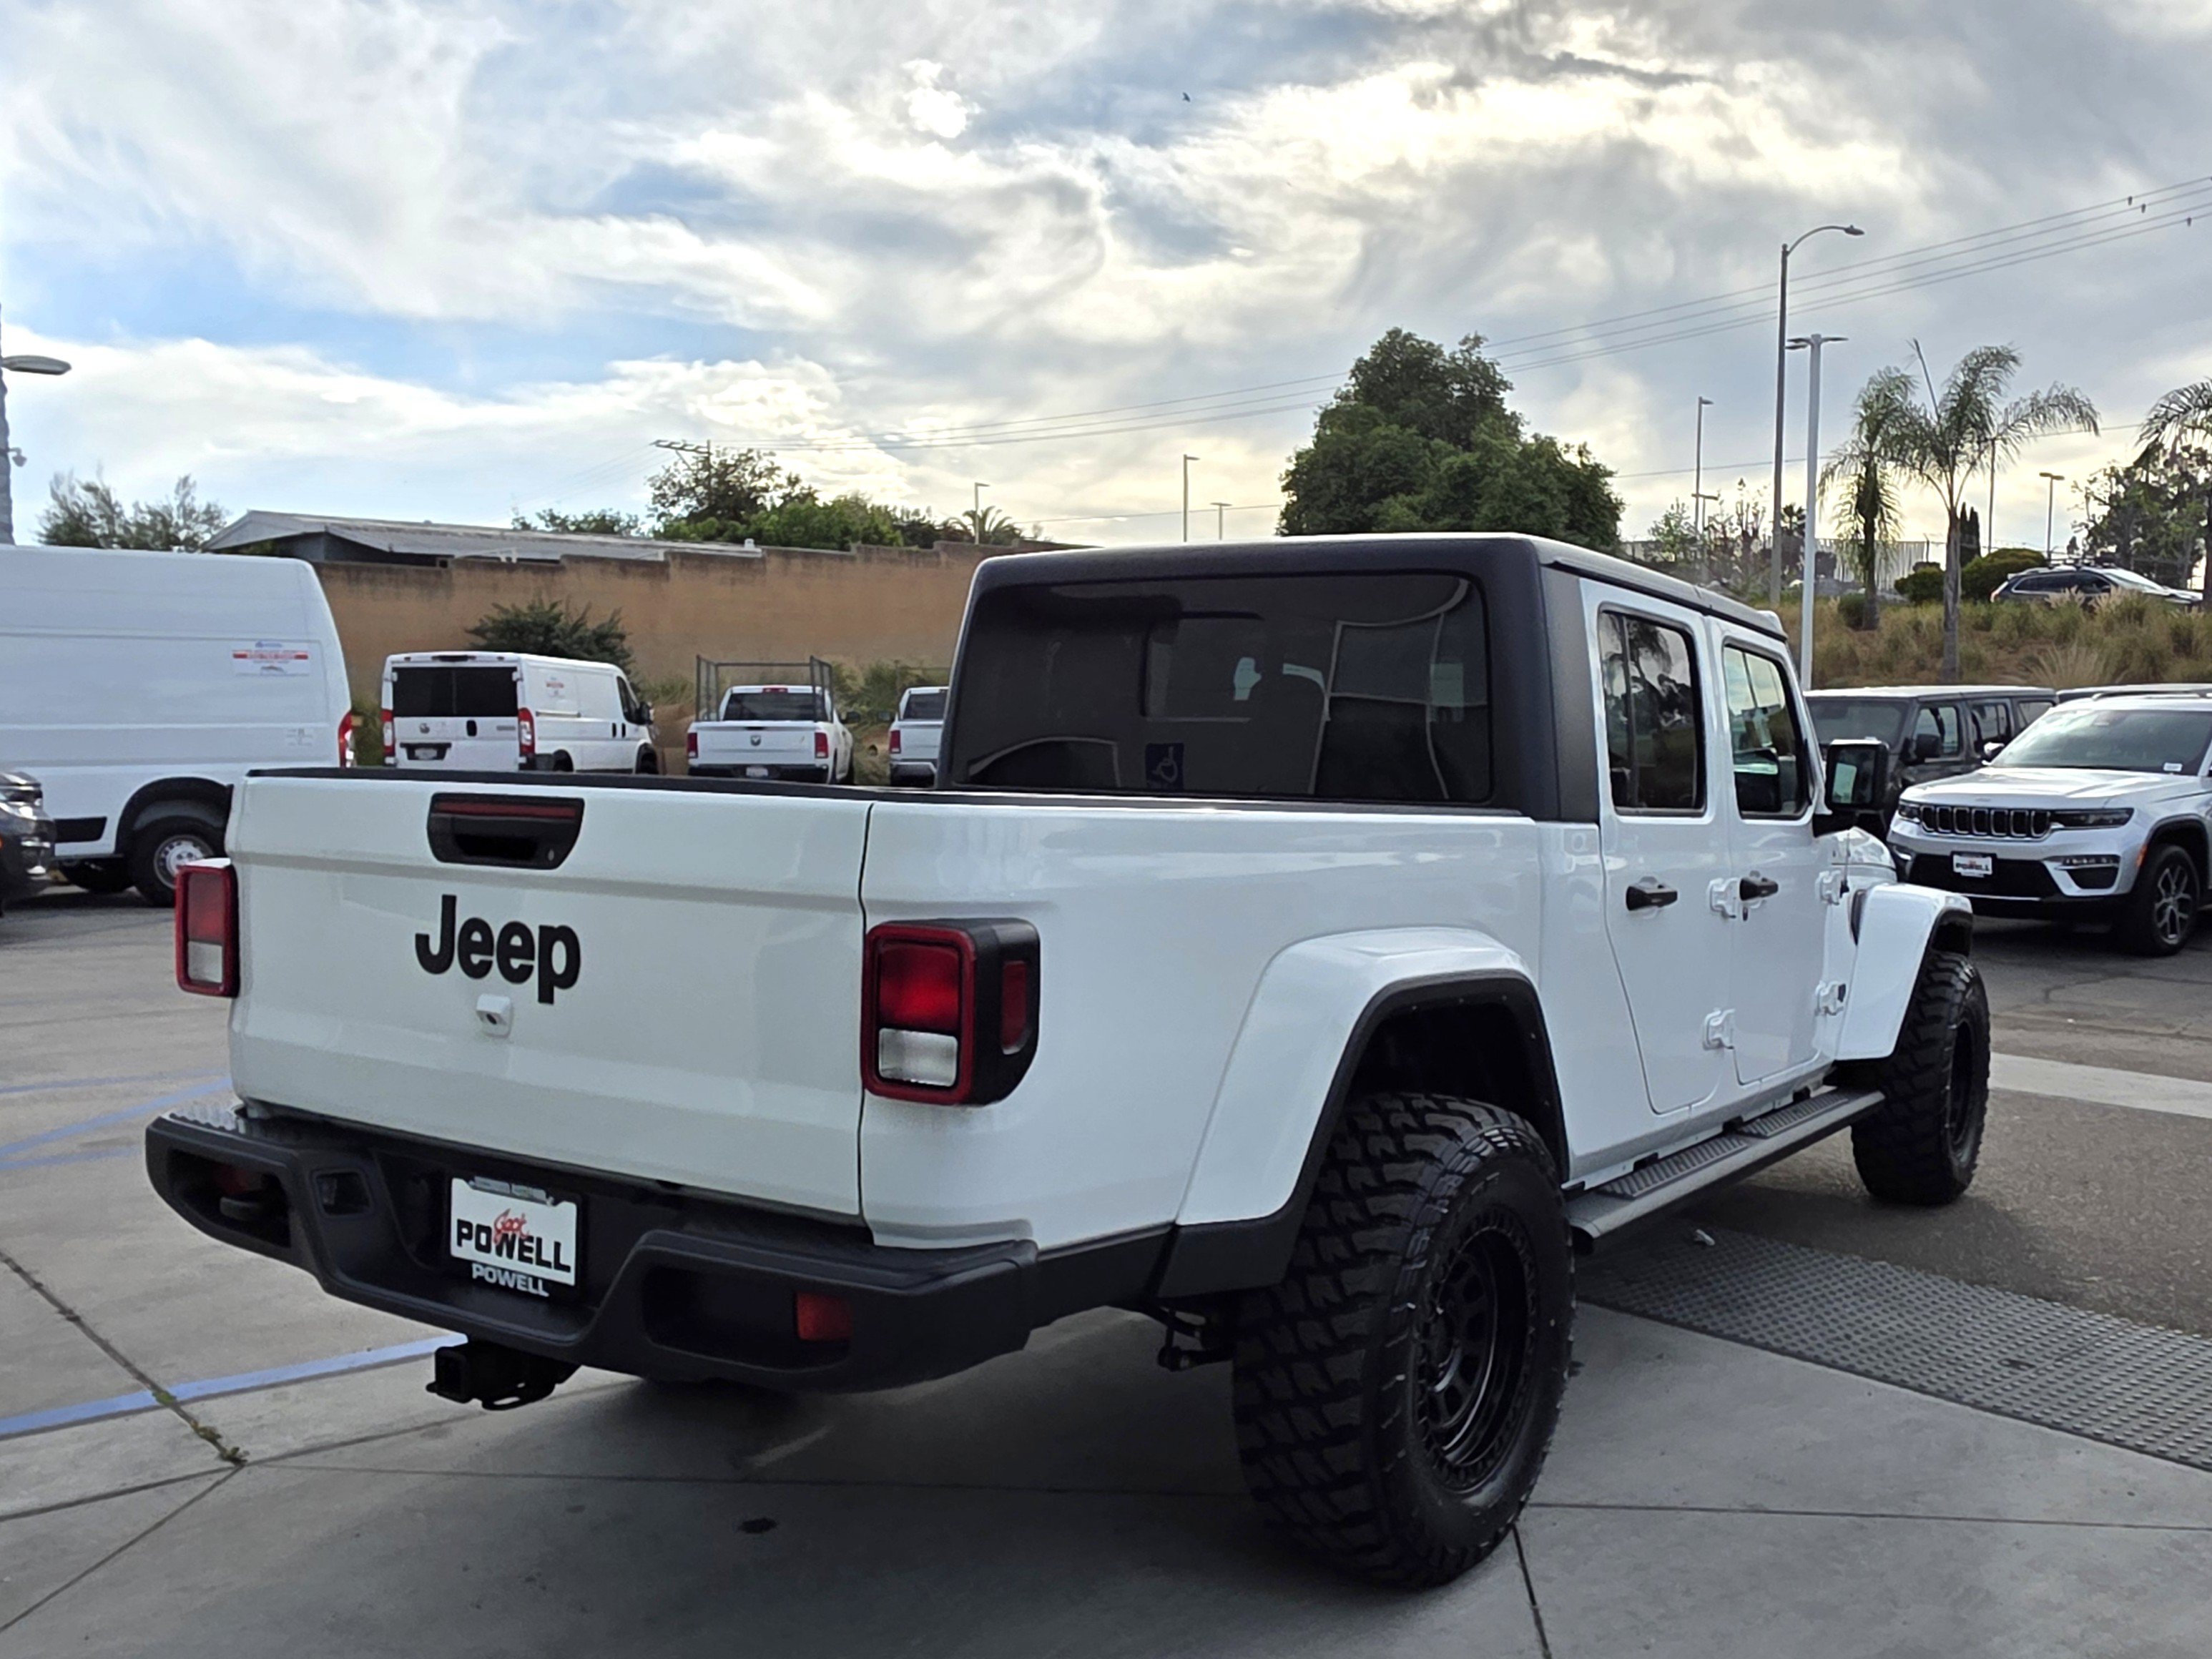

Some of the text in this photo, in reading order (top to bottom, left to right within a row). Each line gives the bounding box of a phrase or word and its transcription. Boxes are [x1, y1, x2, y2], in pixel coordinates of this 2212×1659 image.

[416, 894, 581, 1005] Jeep
[457, 1219, 571, 1273] POWELL
[472, 1263, 549, 1296] POWELL
